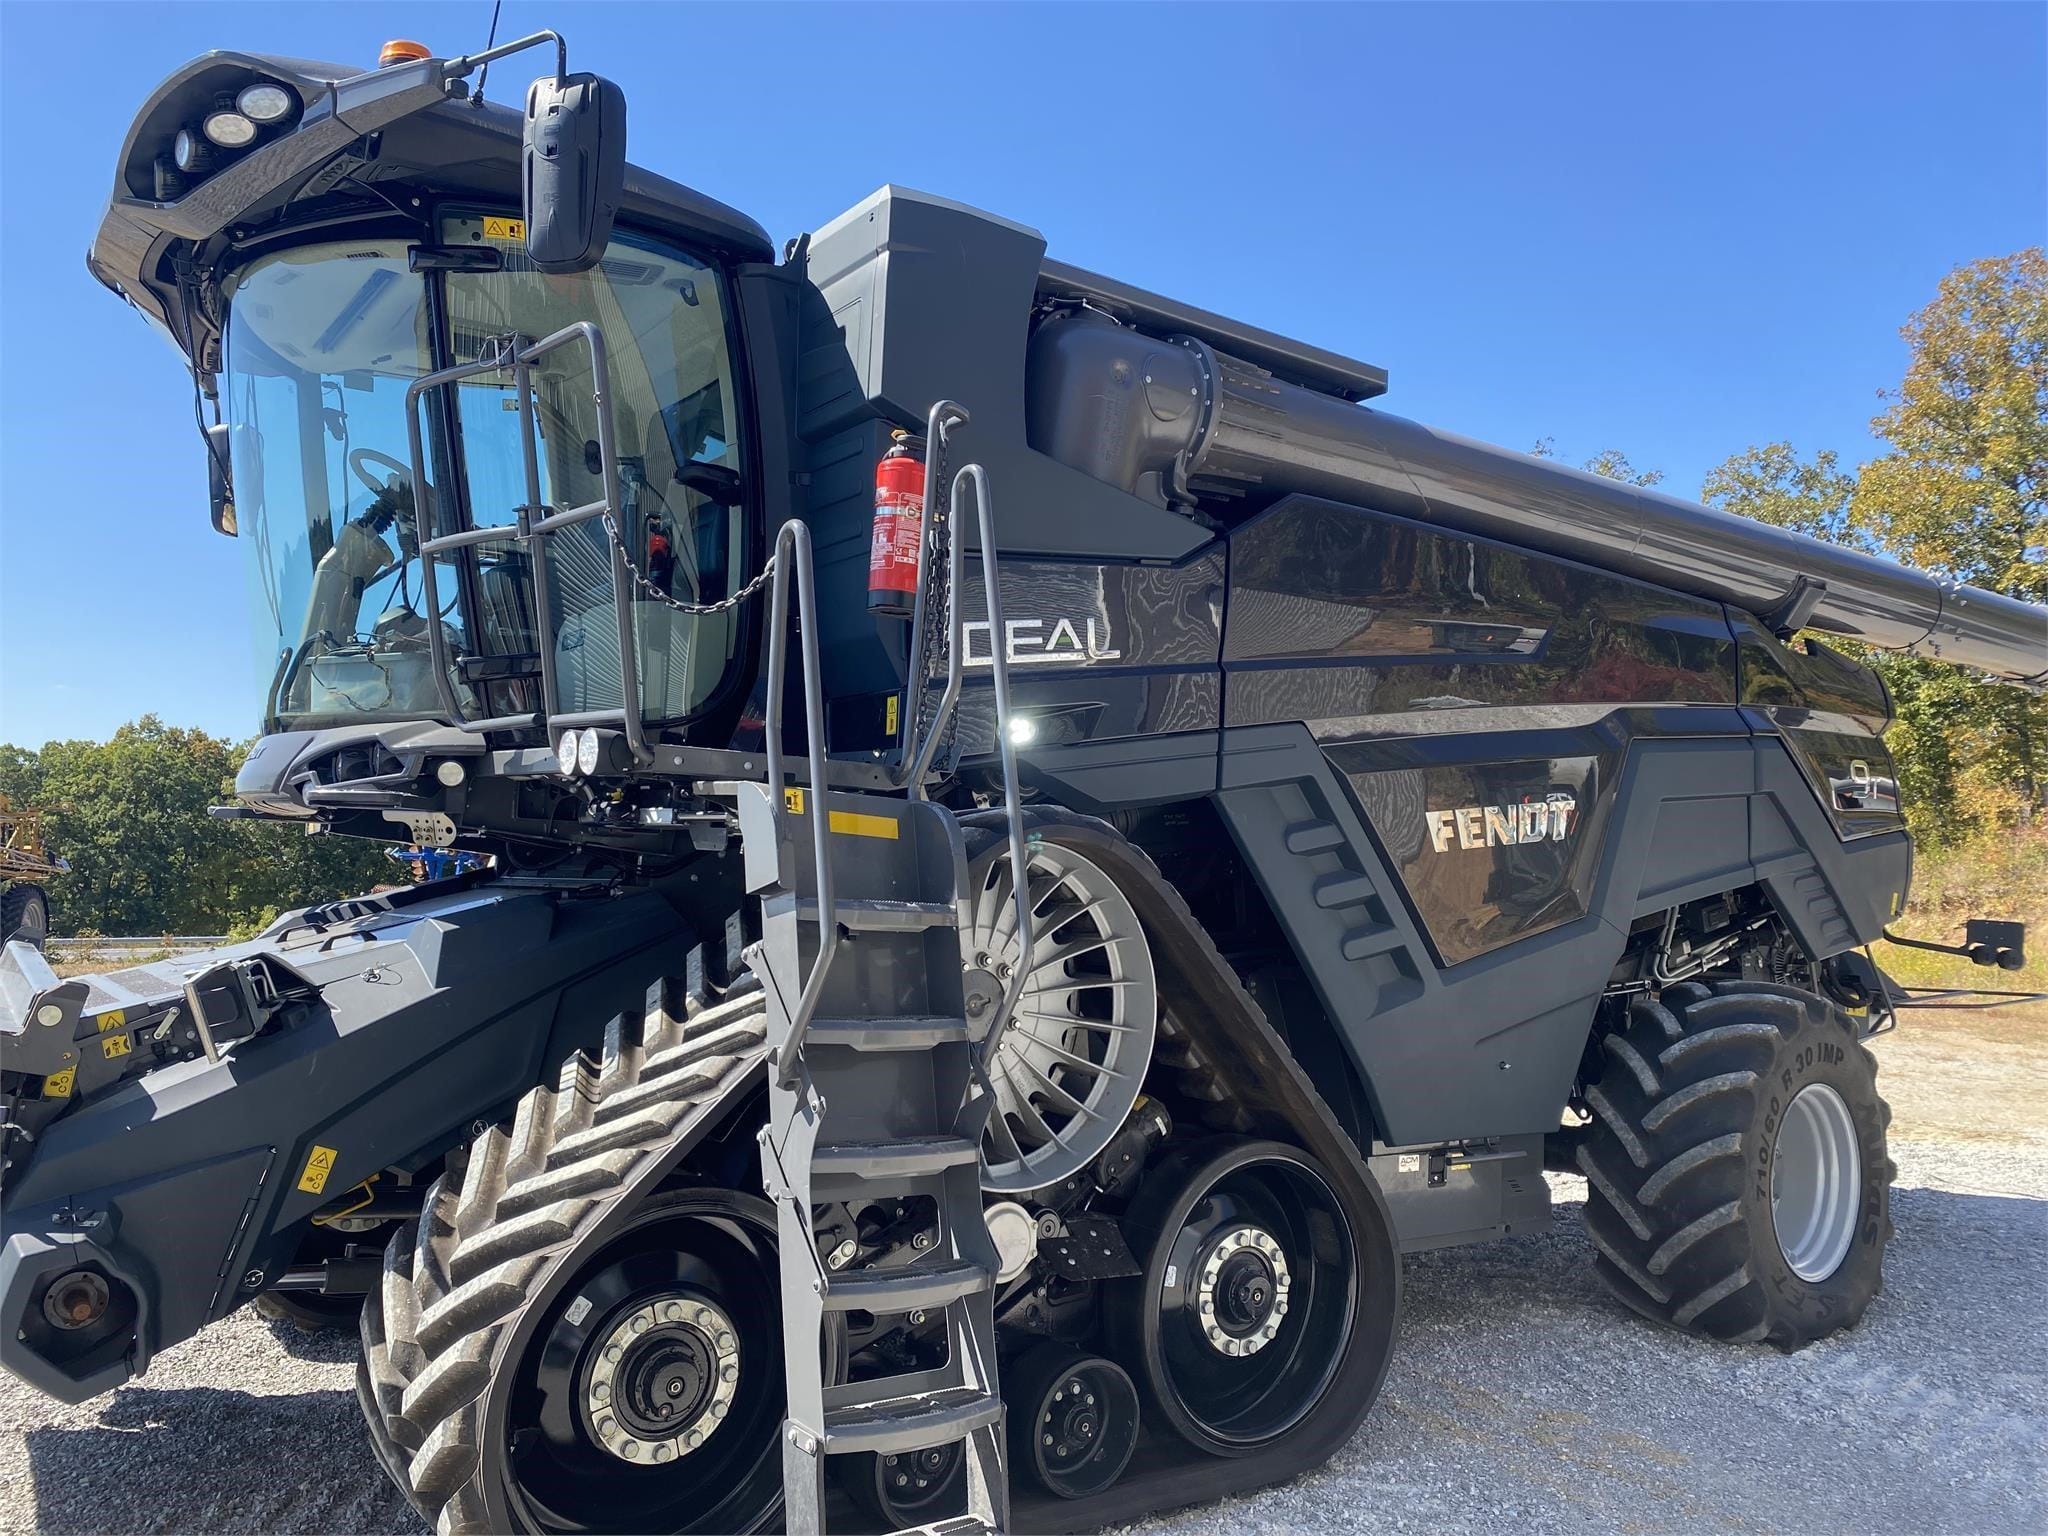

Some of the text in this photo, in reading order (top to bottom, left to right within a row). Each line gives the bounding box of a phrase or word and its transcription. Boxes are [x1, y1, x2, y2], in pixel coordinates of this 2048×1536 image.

[961, 617, 1121, 667] DEAL
[1425, 800, 1576, 853] FENDT
[1755, 1042, 1845, 1202] 710/60 R 30 IMP
